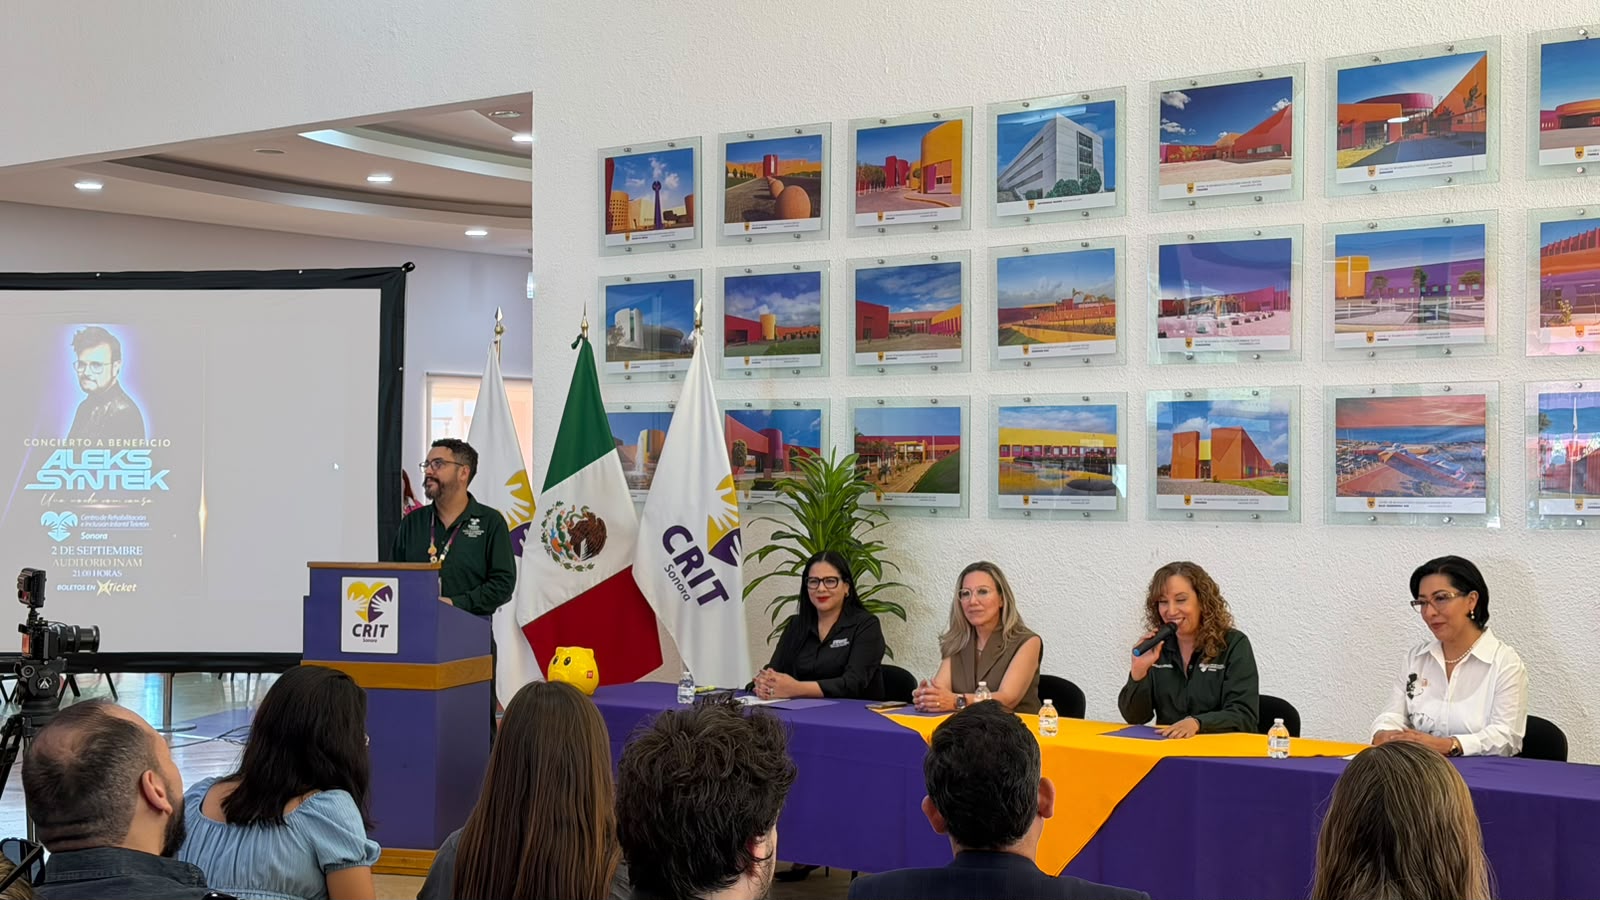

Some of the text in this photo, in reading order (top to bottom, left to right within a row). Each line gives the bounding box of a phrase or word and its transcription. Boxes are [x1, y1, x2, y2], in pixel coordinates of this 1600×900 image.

[24, 438, 171, 447] CONCIERTO A BENEFICIO
[41, 449, 153, 470] ALEKS
[23, 469, 171, 491] SYNTEK
[80, 513, 99, 521] Centro
[99, 513, 107, 521] de
[80, 531, 108, 540] Sonora
[51, 546, 144, 556] 2 DE SEPTIEMBRE
[52, 558, 143, 567] AUDITORIO INAM
[662, 525, 730, 606] CRIT
[92, 569, 122, 577] HORAS
[664, 563, 691, 602] Sonora
[352, 623, 389, 638] CRIT
